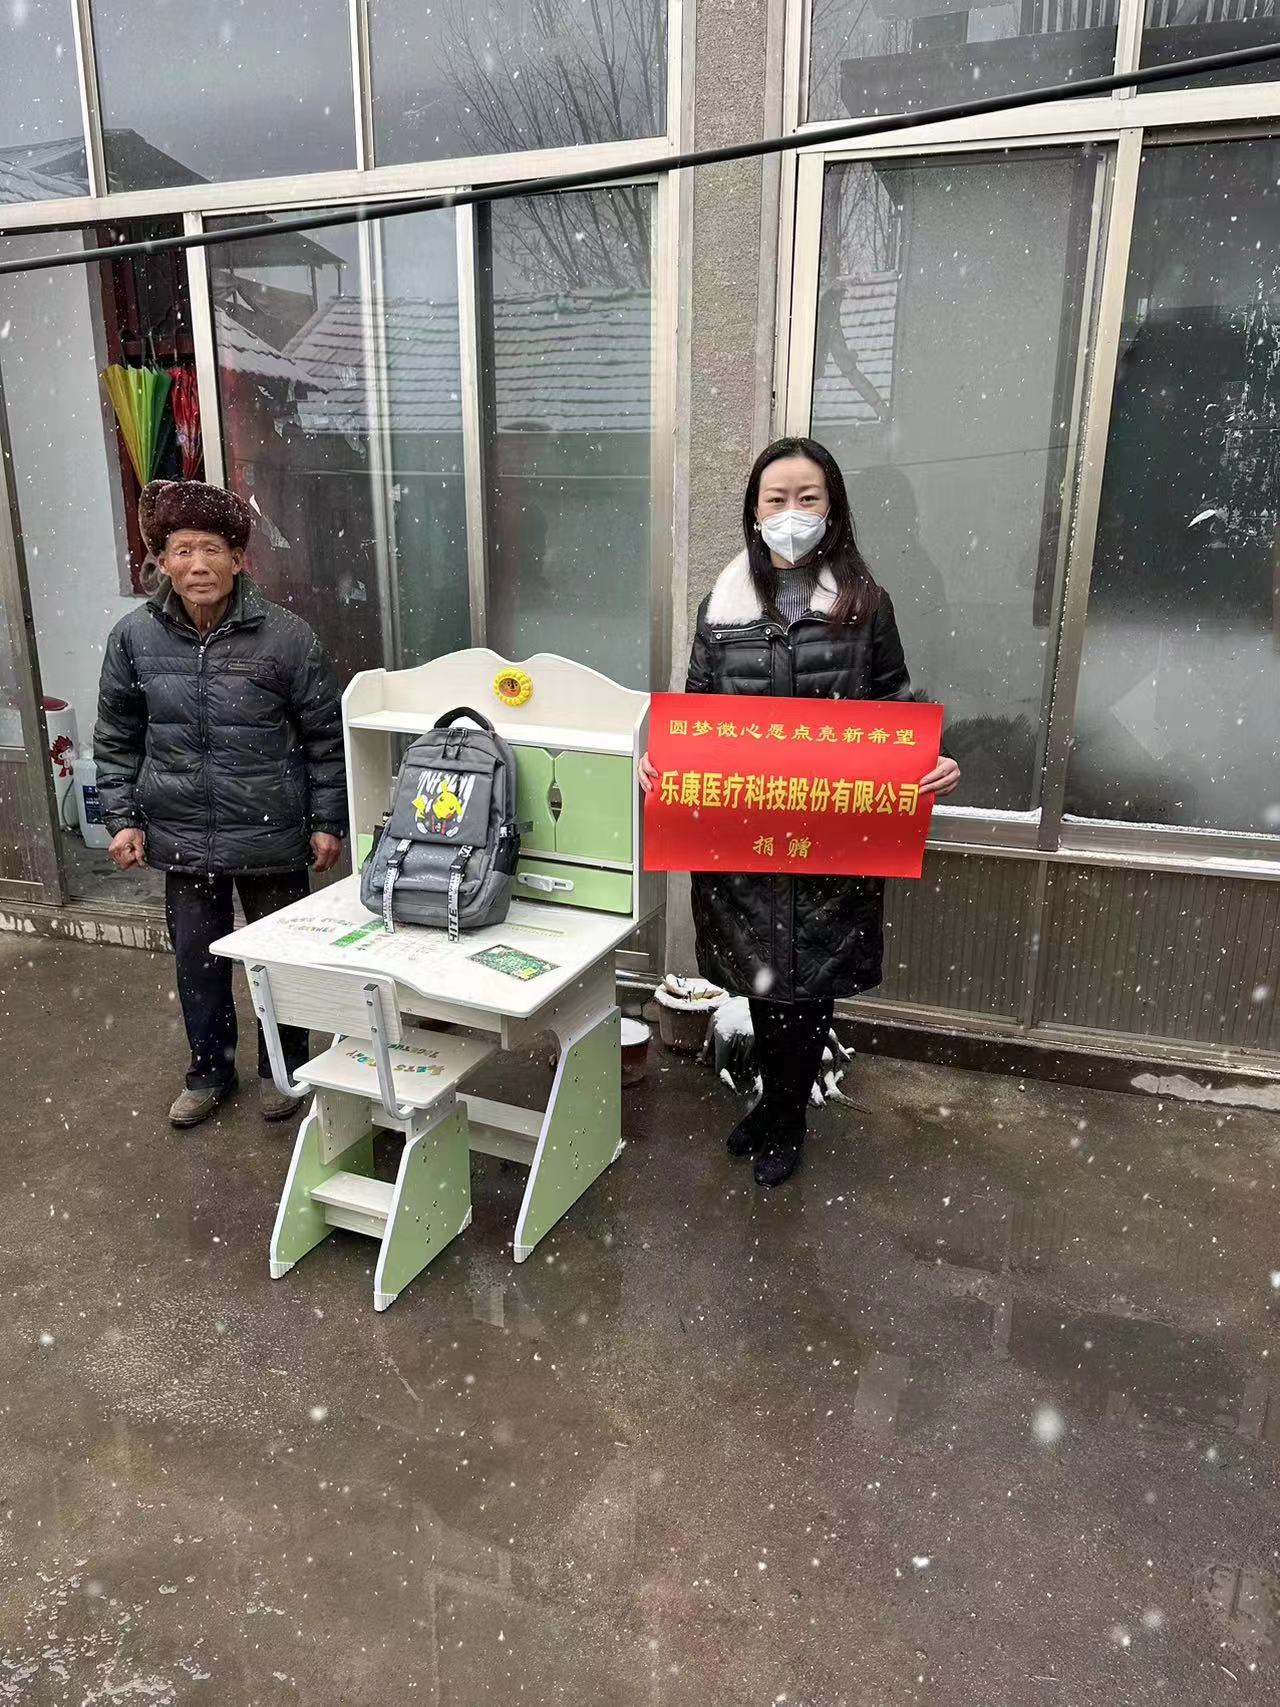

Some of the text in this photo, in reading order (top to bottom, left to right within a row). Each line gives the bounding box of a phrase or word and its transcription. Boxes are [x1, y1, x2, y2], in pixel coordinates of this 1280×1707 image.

[669, 719, 917, 746] 圆梦微心愿点亮新希望
[660, 769, 920, 816] 乐康医疗科技股份有限公司
[752, 835, 812, 858] 捐赠
